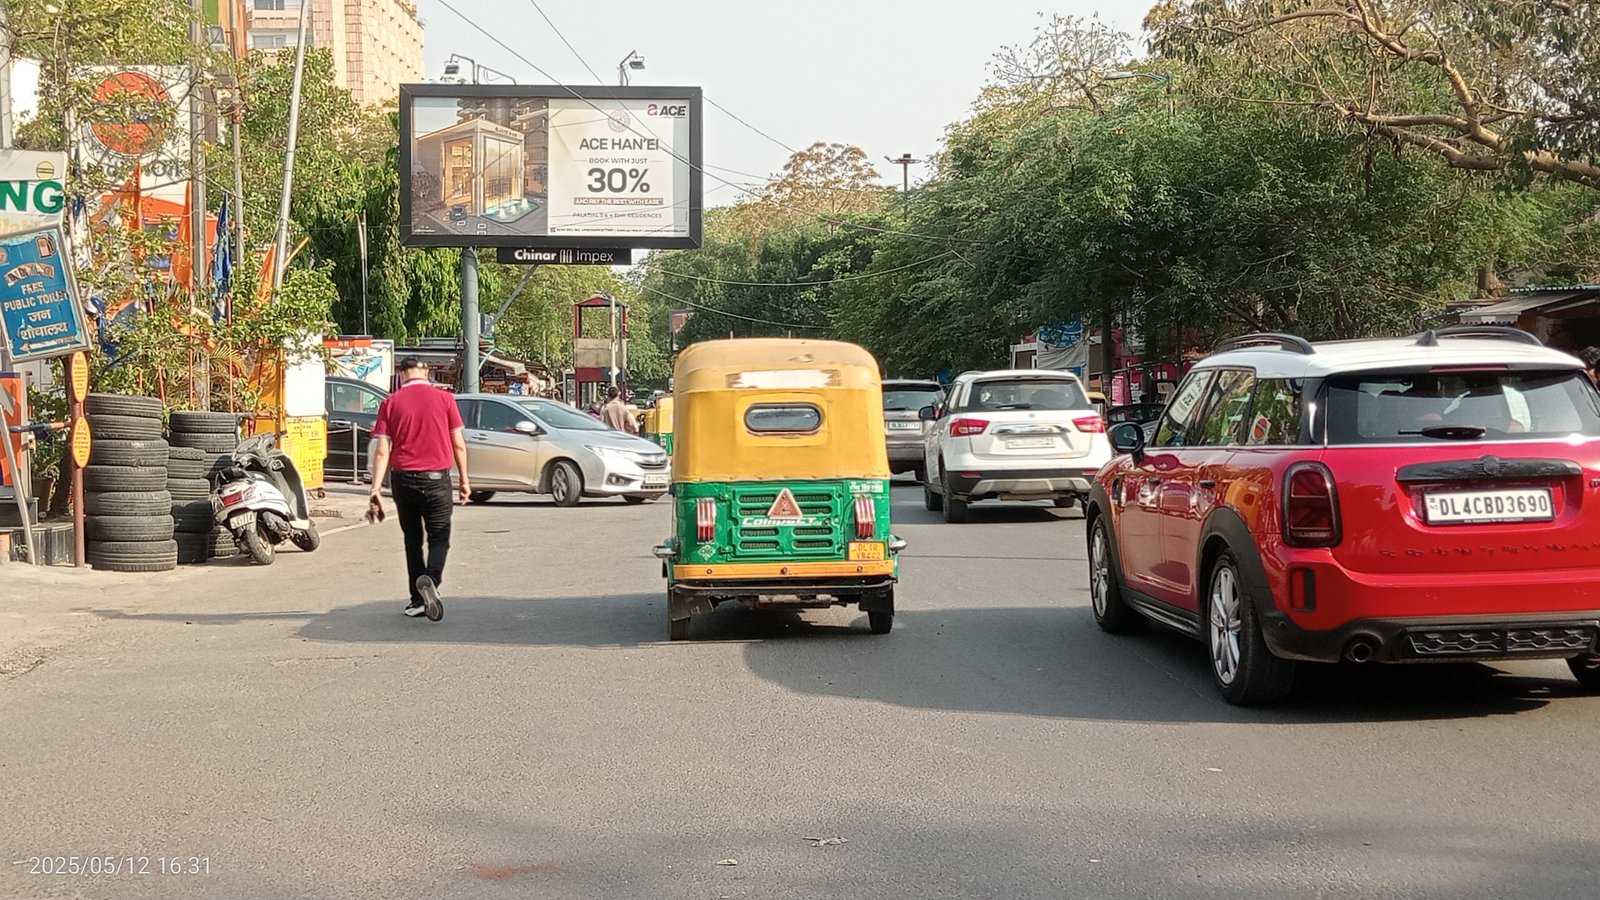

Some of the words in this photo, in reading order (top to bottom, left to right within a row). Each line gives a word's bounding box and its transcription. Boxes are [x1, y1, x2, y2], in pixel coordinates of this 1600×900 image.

[660, 105, 687, 117] ACE
[579, 138, 609, 151] ACE
[631, 157, 649, 165] JUST
[587, 167, 651, 194] 30%
[514, 248, 557, 261] Chinar
[577, 249, 614, 263] Impex
[4, 296, 37, 312] PUBLIC
[27, 309, 52, 322] जन
[1438, 495, 1549, 516] DL4CBD3690
